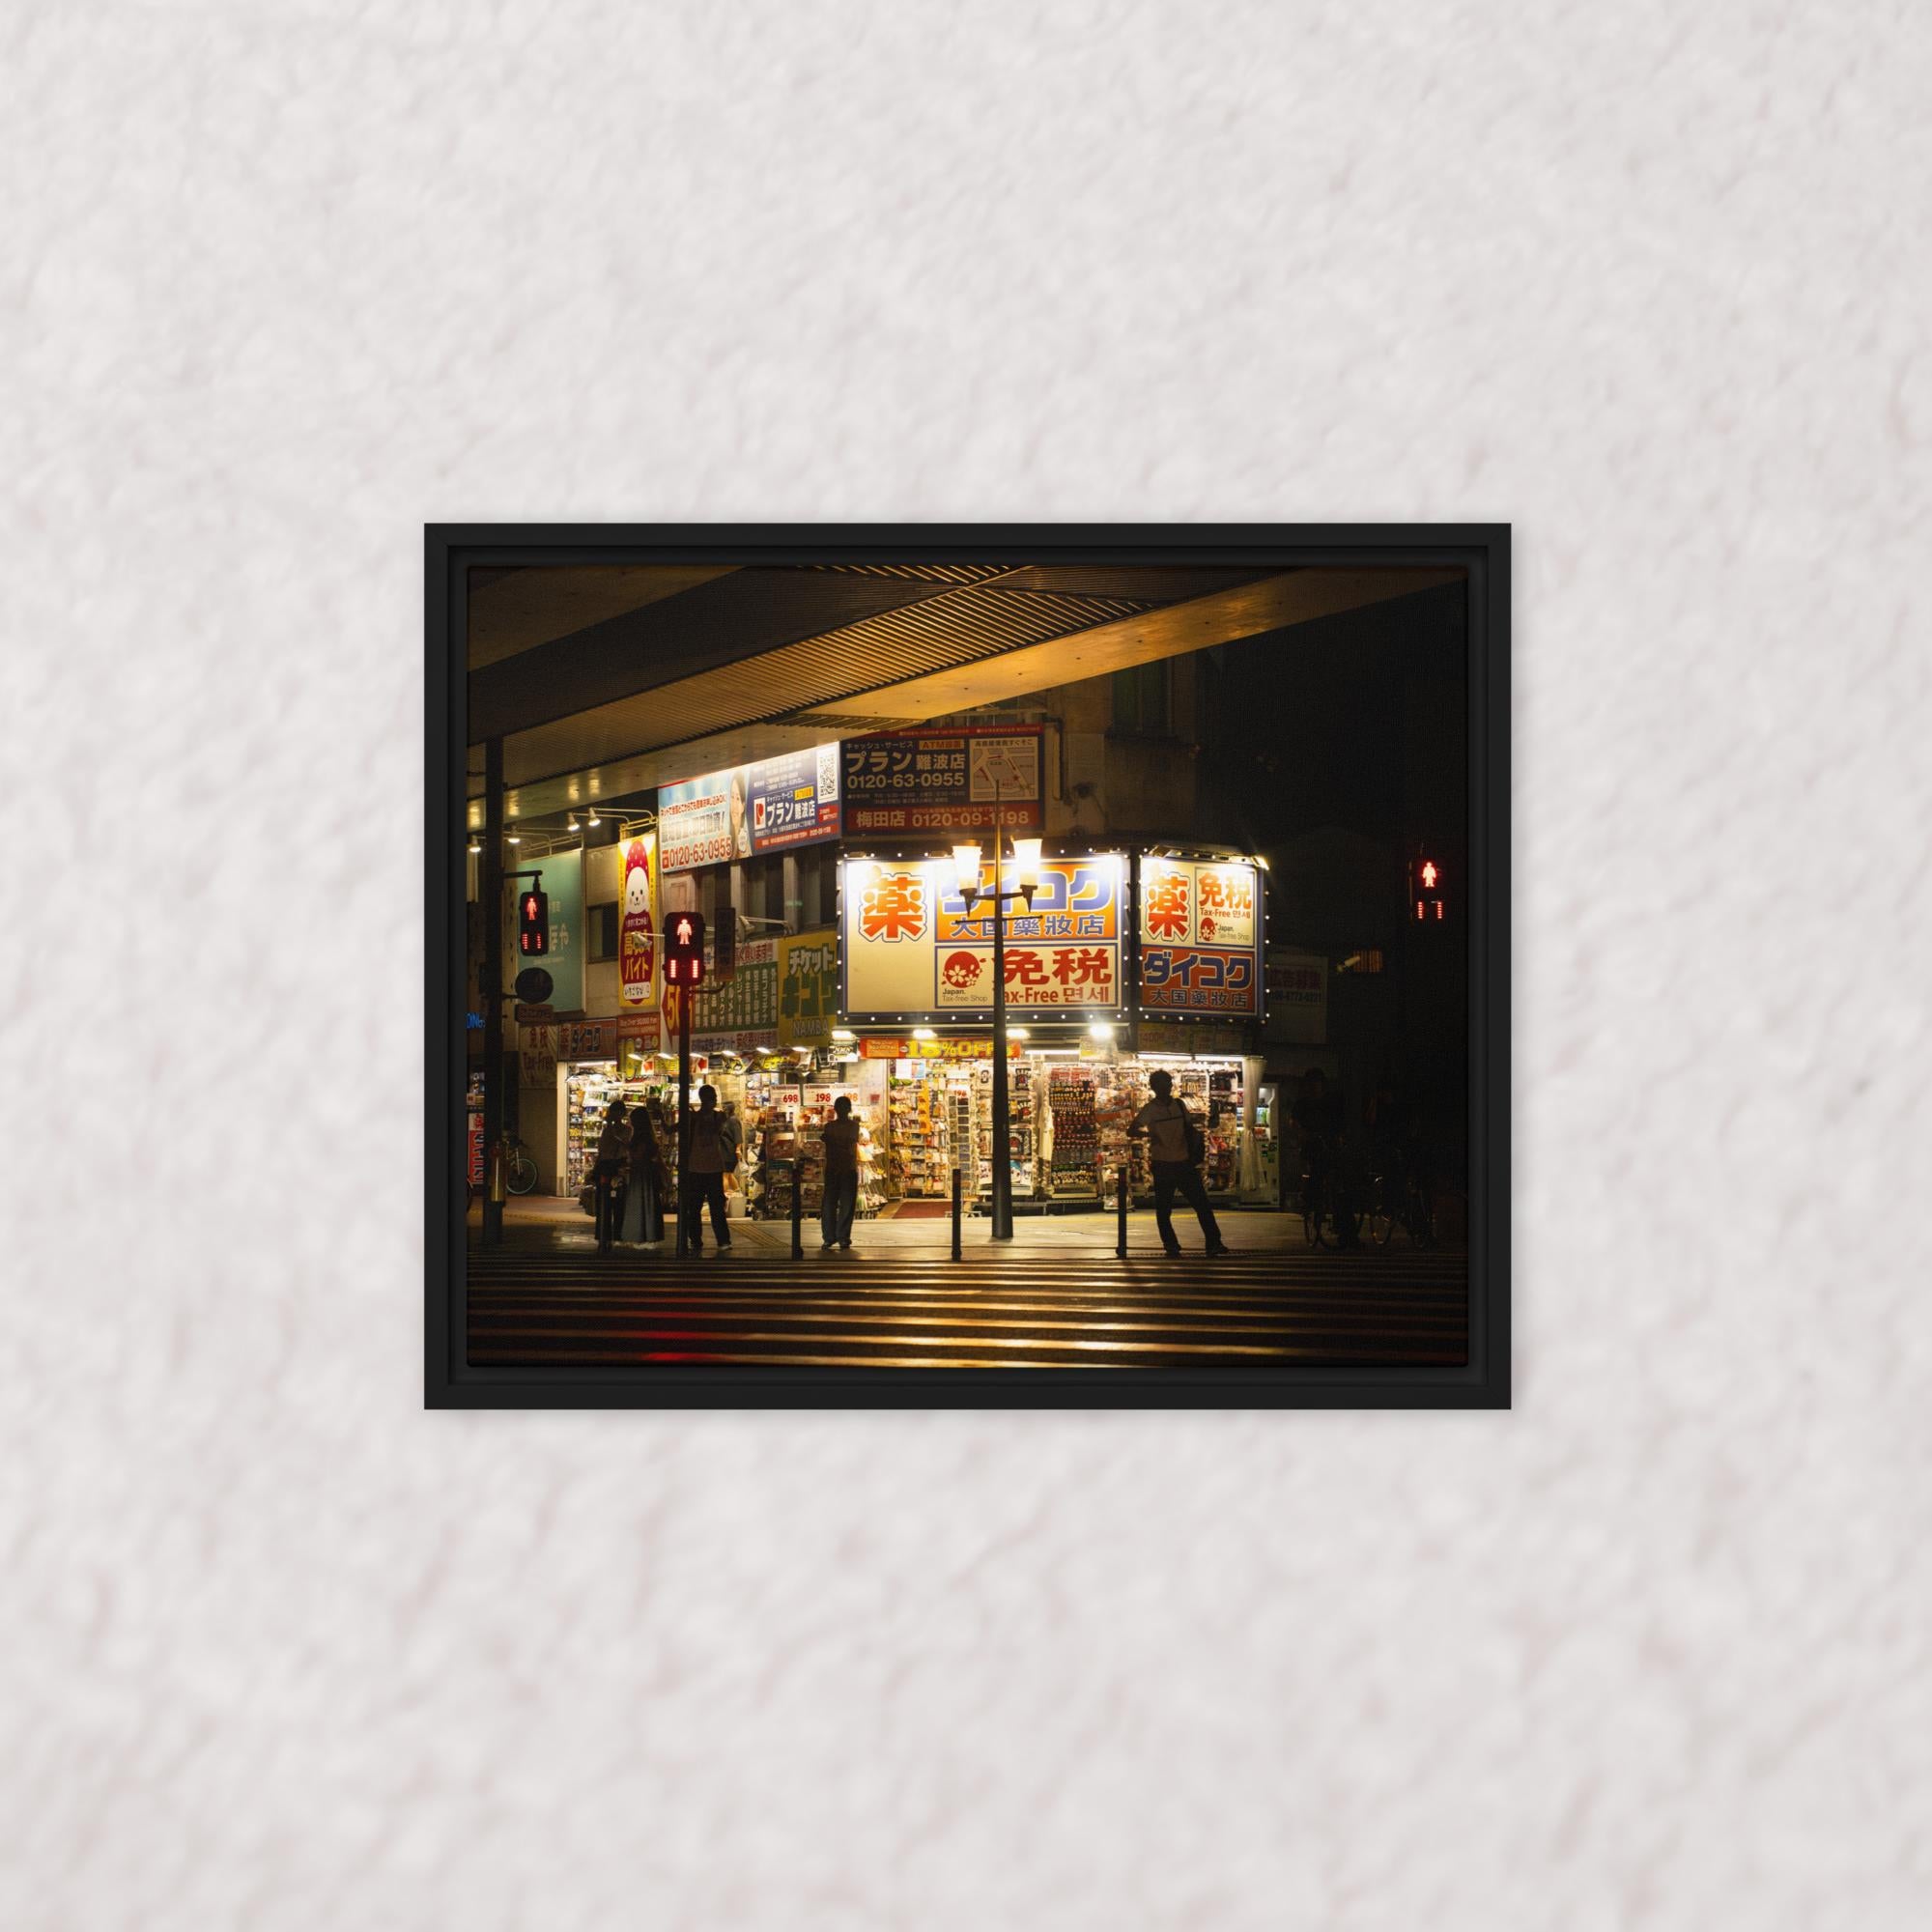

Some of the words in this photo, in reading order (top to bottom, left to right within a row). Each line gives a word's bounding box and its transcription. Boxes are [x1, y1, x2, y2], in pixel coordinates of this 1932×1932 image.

[846, 751, 912, 773] プラン
[916, 753, 965, 771] 難波店
[847, 773, 965, 789] 0120-63-0955
[766, 802, 794, 827] プラン
[857, 810, 906, 828] 梅田店
[912, 810, 1029, 828] 0120-09-1198
[669, 836, 732, 867] 0120-63-0955
[1199, 871, 1253, 910] 免税
[862, 874, 925, 940] 薬
[1147, 873, 1189, 940] 薬
[1200, 907, 1232, 919] Tax-Free
[625, 955, 649, 980] バイト
[789, 945, 835, 976] チケット
[991, 948, 1114, 986] 免税
[1143, 950, 1253, 990] ダイコク
[992, 986, 1059, 1005] ax-Free
[792, 1017, 830, 1037] NAMBA
[816, 1094, 831, 1103] 198
